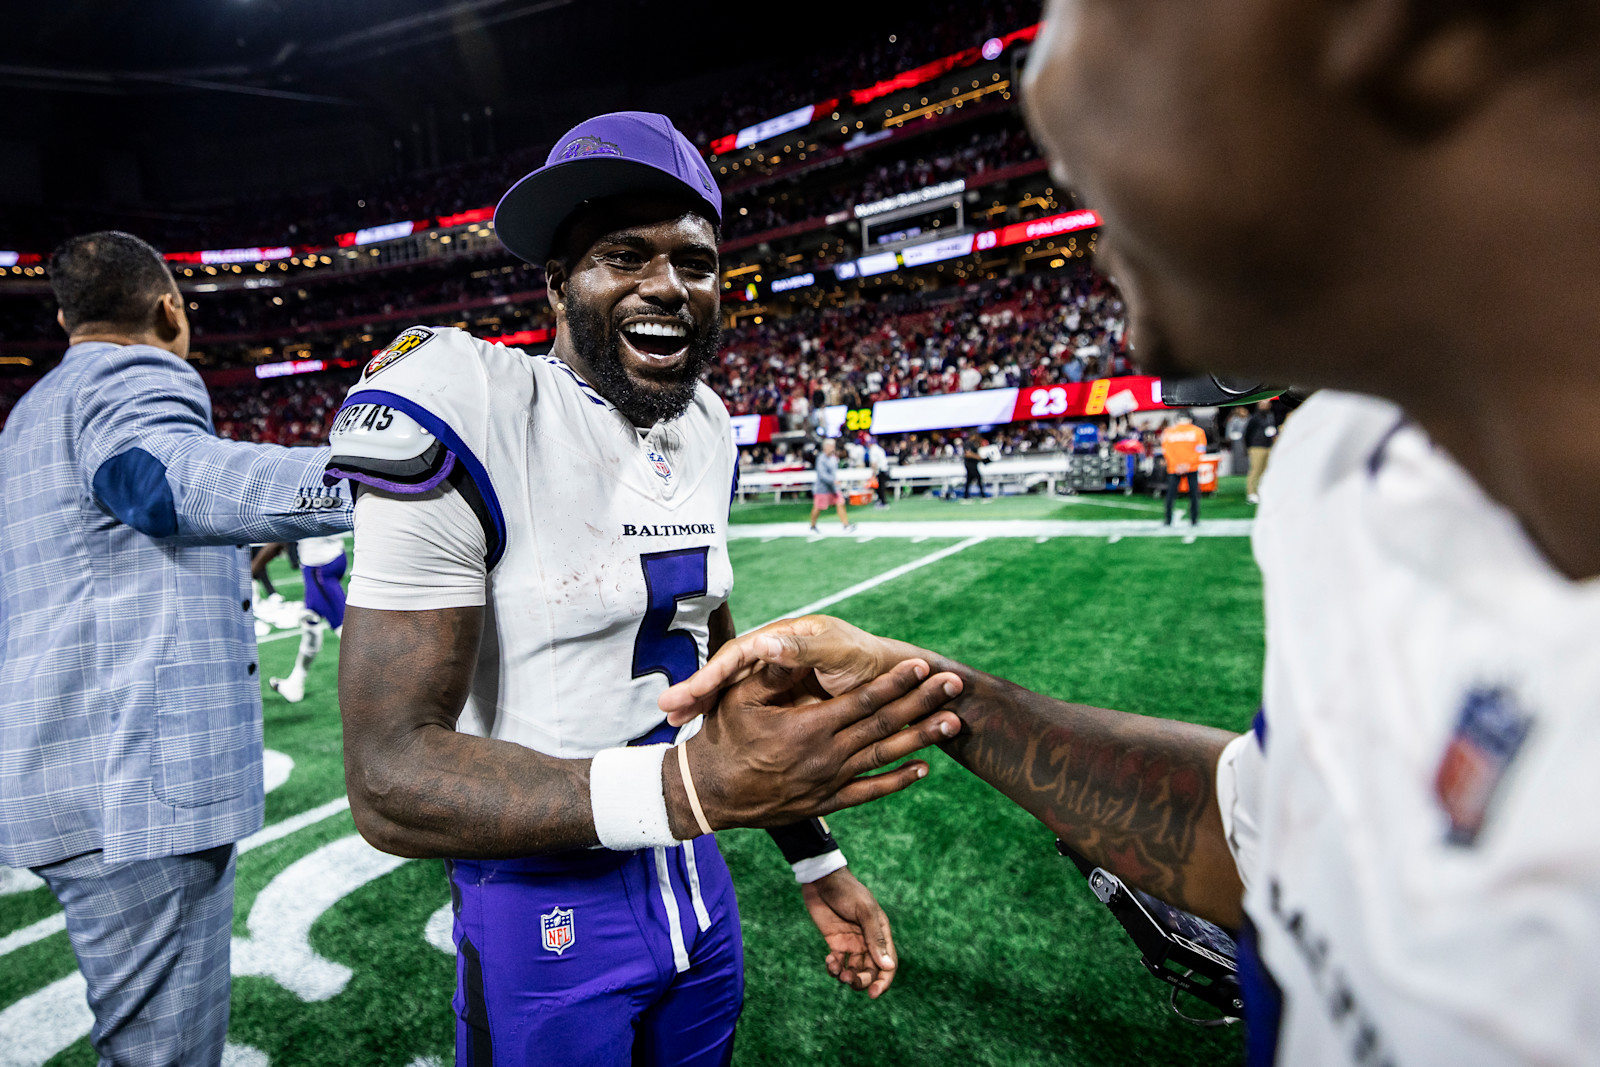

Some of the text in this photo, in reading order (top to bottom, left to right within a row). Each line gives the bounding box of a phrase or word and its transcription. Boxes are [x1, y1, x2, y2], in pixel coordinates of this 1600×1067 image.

[1026, 212, 1097, 238] FALCONS
[1030, 387, 1068, 416] 23
[846, 408, 873, 431] 25
[622, 524, 716, 537] BALTIMORE
[626, 546, 710, 746] 5
[548, 927, 570, 946] NFL
